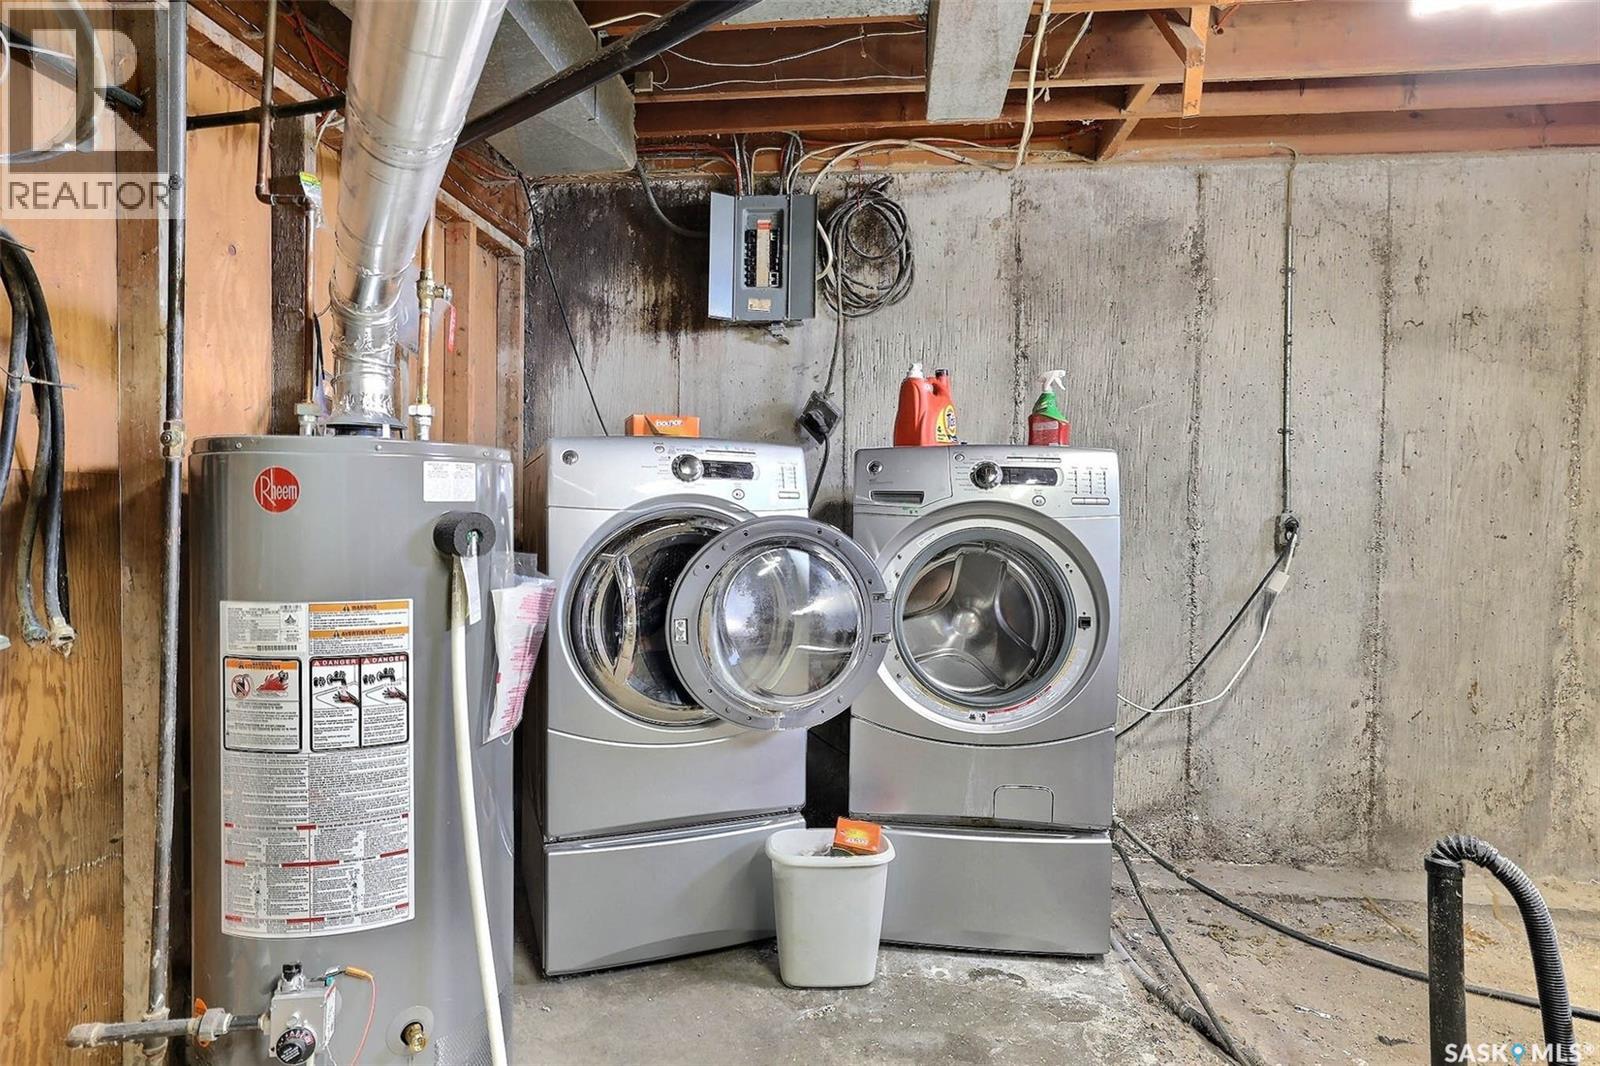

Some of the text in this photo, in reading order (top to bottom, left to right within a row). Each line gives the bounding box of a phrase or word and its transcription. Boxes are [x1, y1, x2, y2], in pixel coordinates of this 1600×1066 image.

[260, 467, 298, 507] Rheem
[341, 629, 387, 637] AVERTISSEMENT
[322, 658, 357, 666] DANGER
[372, 655, 406, 664] DANGER
